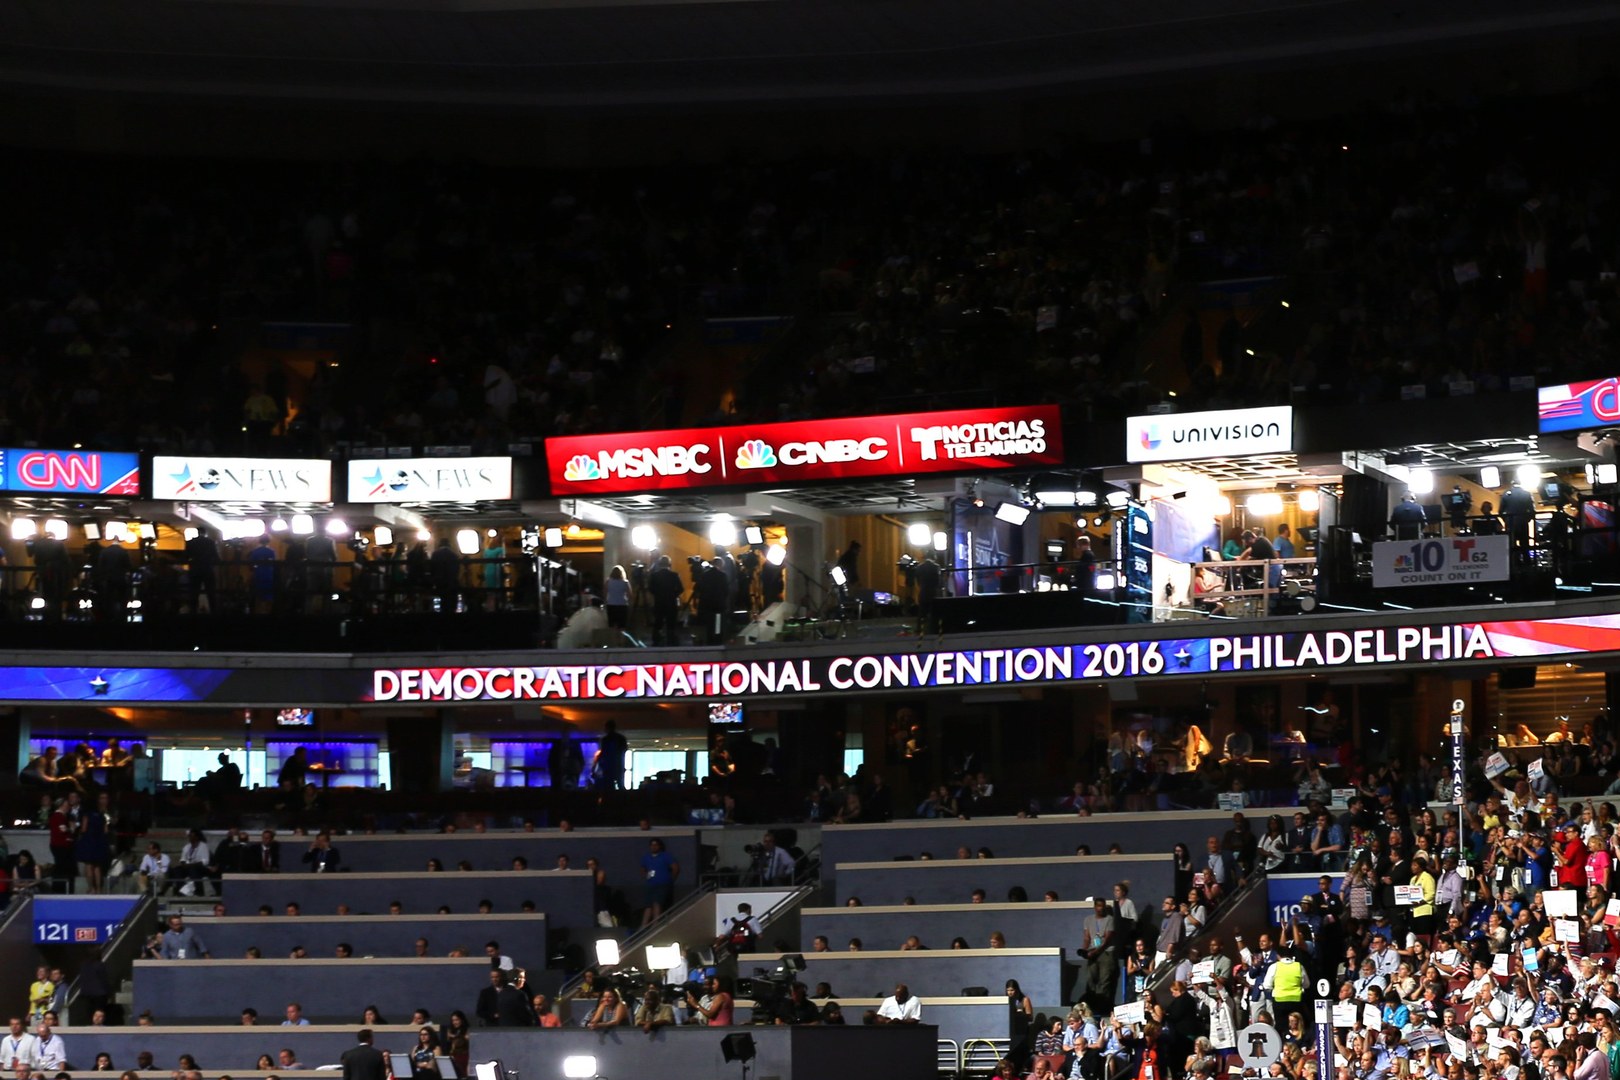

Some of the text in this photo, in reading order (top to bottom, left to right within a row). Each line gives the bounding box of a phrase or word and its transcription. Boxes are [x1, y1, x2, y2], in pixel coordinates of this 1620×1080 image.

[942, 419, 1046, 444] NOTICIAS
[778, 436, 889, 464] CNBC
[946, 437, 1046, 459] TELEMUNDO
[17, 452, 101, 491] CNN
[599, 444, 712, 479] MSNBC
[225, 467, 311, 491] NEWS
[413, 467, 493, 491] NEWS
[1411, 541, 1444, 573] 10
[1472, 552, 1488, 562] 62
[1401, 571, 1481, 583] COUNT ON IT
[1209, 625, 1495, 671] PHILADELPHIA
[374, 642, 1165, 701] DEMOCRATIC NATIONAL CONVENTION 2016
[1452, 733, 1462, 798] TEXAS
[38, 924, 69, 940] 121
